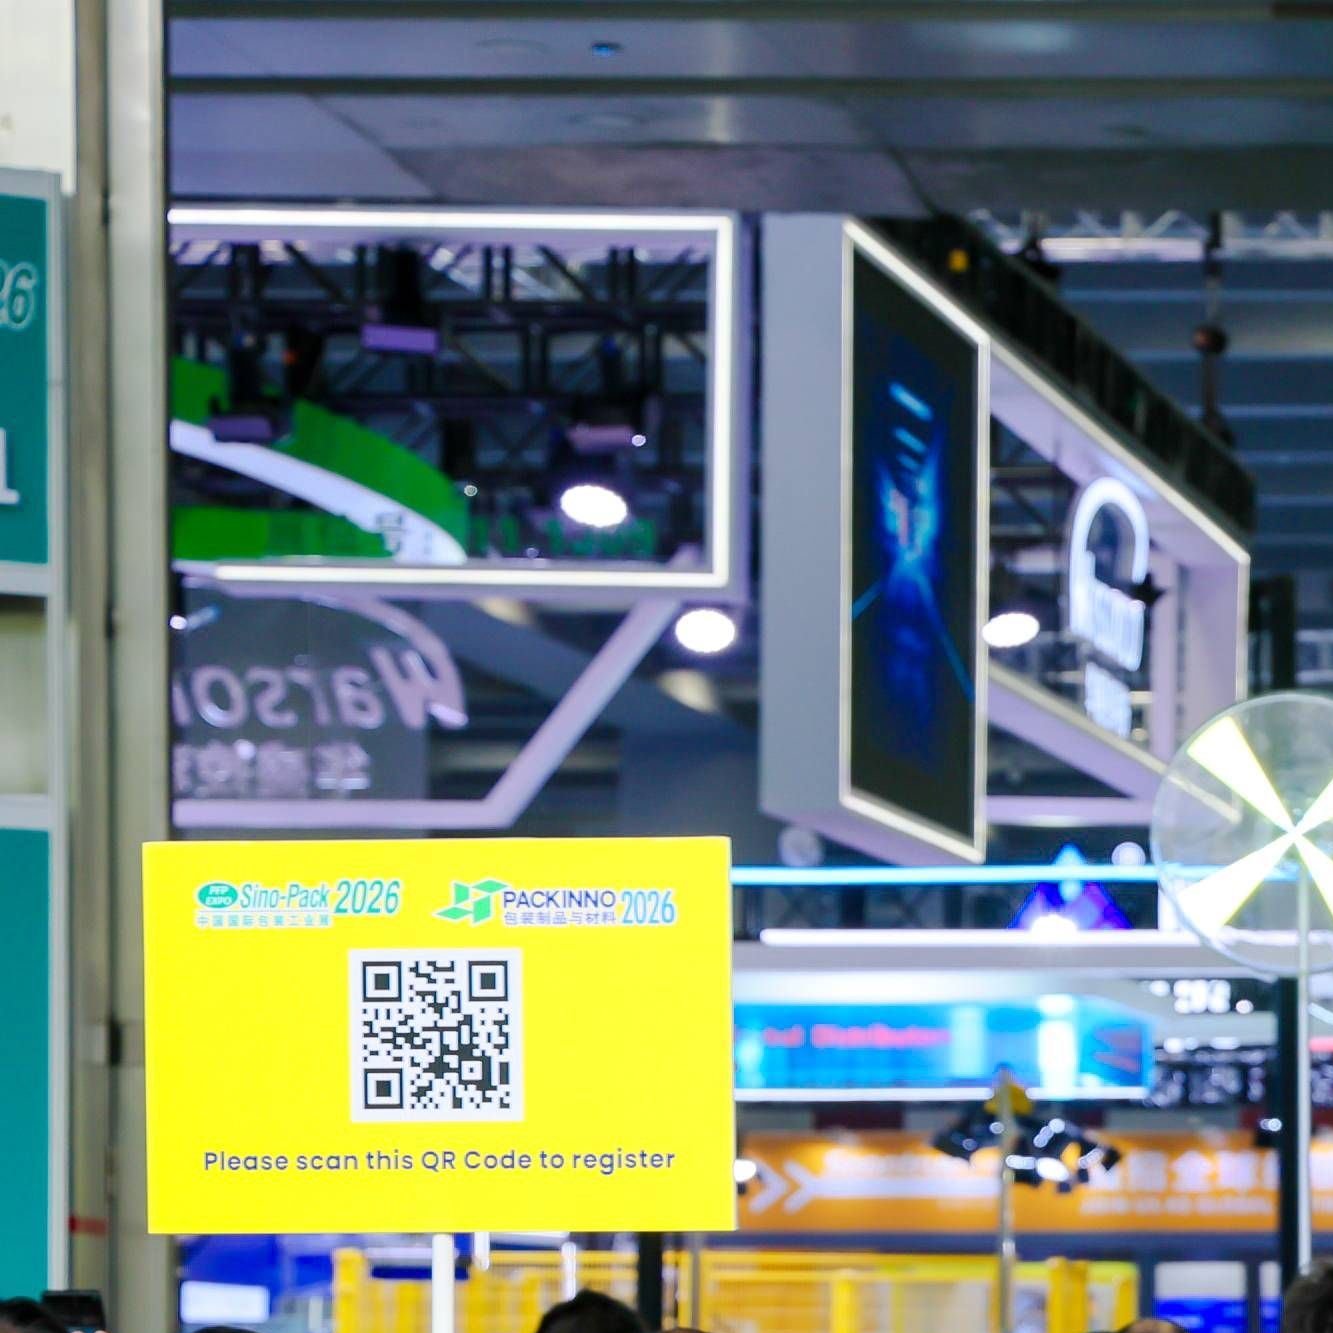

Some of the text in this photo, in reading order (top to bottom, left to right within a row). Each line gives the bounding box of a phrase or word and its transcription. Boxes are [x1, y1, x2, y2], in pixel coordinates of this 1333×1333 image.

[0, 261, 38, 331] 6
[239, 879, 401, 914] Sino-Pack 2026
[503, 889, 676, 925] PACKINNO 2026
[503, 911, 616, 926] 包装制品与材料
[203, 1147, 676, 1176] Please scan this QR Code to register
